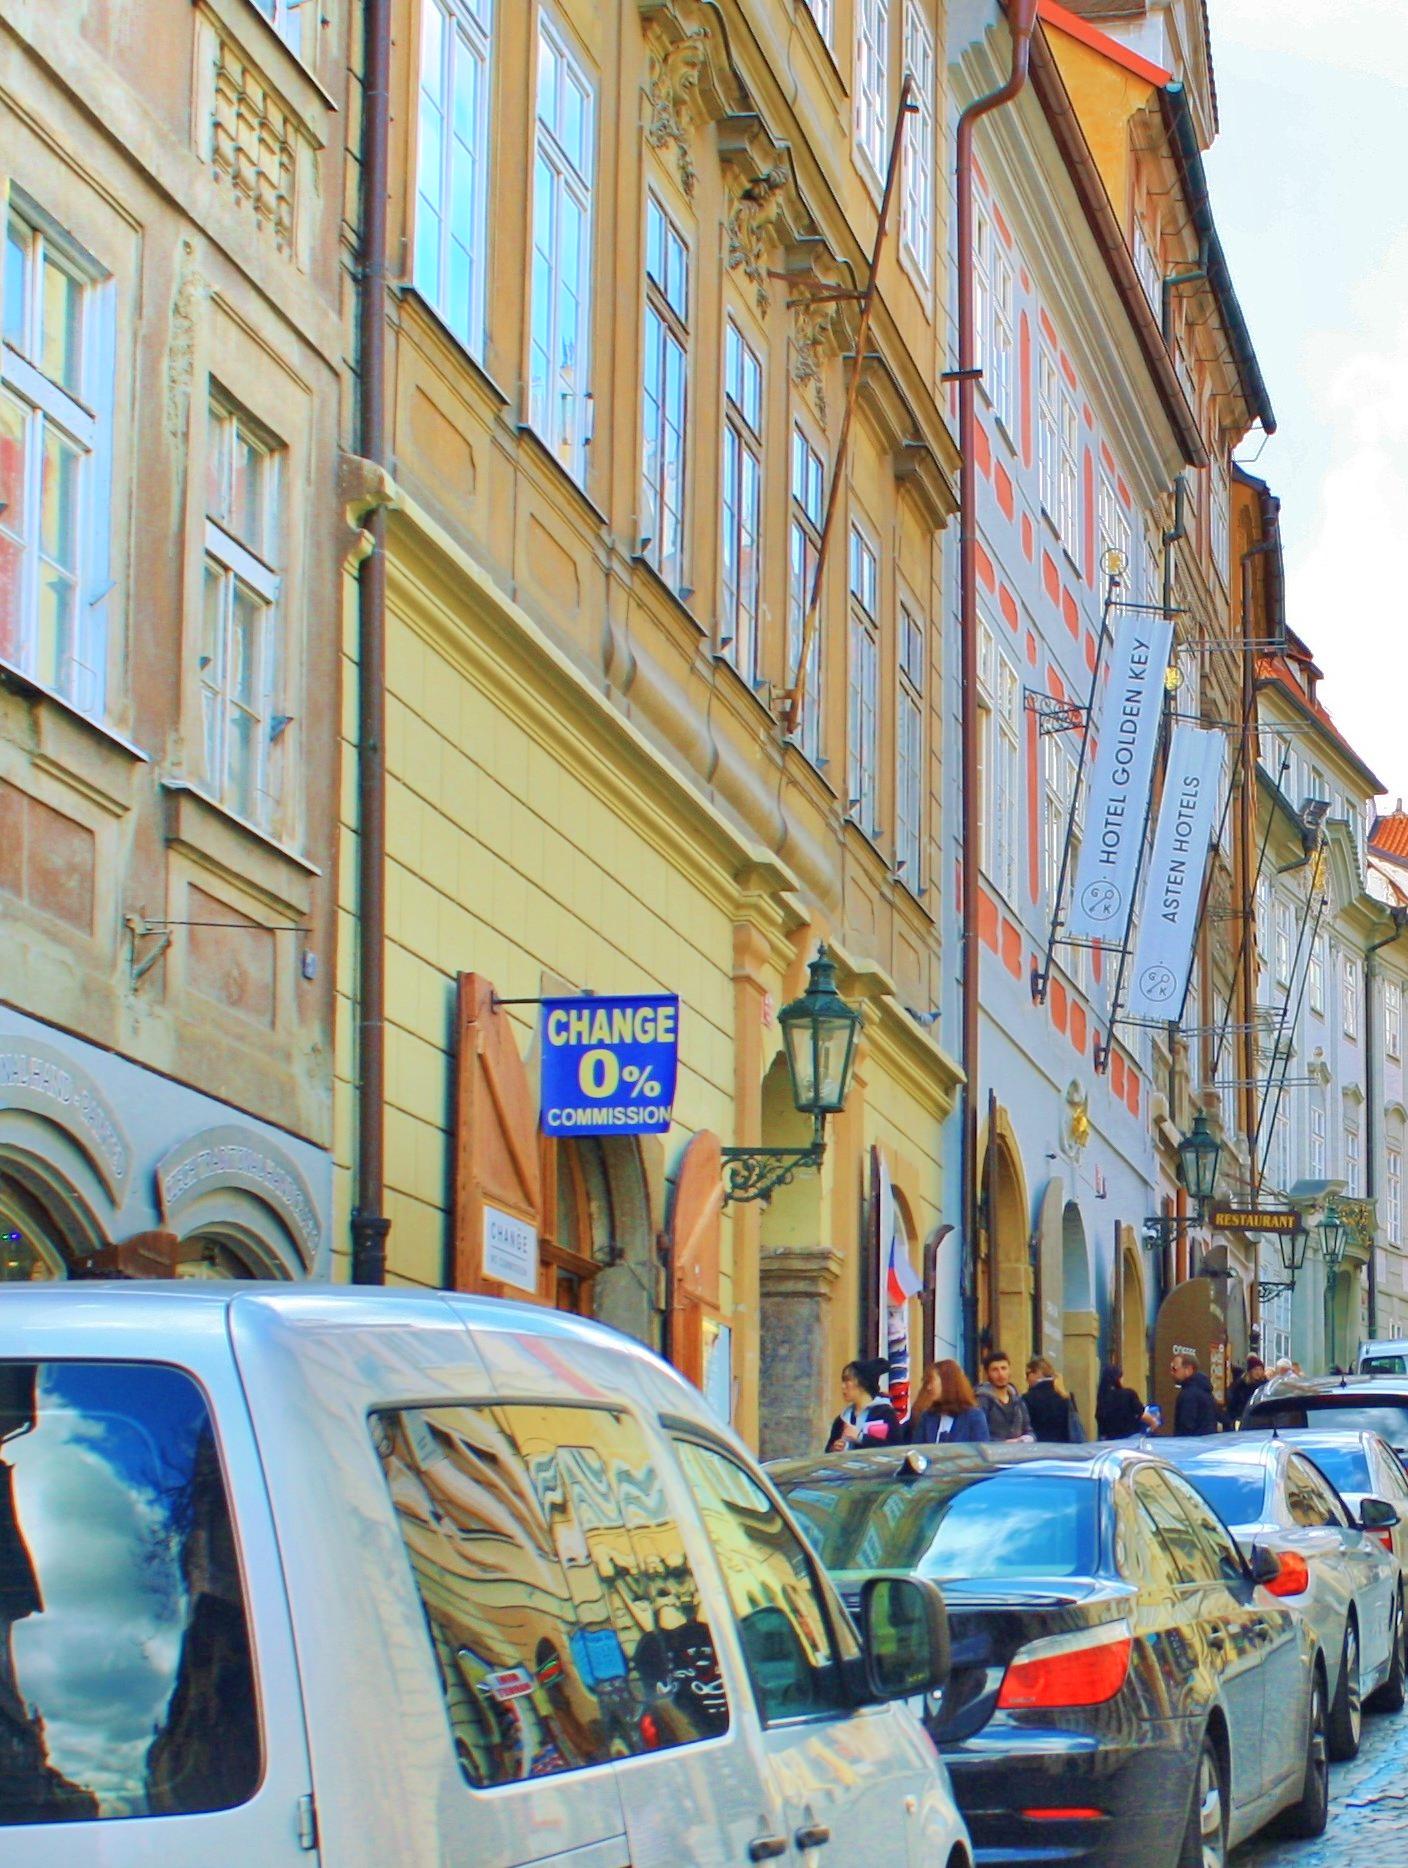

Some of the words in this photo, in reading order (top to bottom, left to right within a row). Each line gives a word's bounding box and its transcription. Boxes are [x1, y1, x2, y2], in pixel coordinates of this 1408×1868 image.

[1128, 638, 1150, 681] KEY
[1111, 689, 1144, 786] GOLDEN
[1099, 794, 1127, 866] HOTEL
[1173, 775, 1200, 853] HOTELS
[1102, 904, 1112, 915] K
[1161, 861, 1186, 924] ASTEN
[547, 1006, 676, 1047] CHANGE
[578, 1048, 661, 1099] 0%
[547, 1105, 672, 1126] COMMISSION
[490, 1222, 527, 1254] CHANGE
[1215, 1212, 1296, 1229] RESTAURANT
